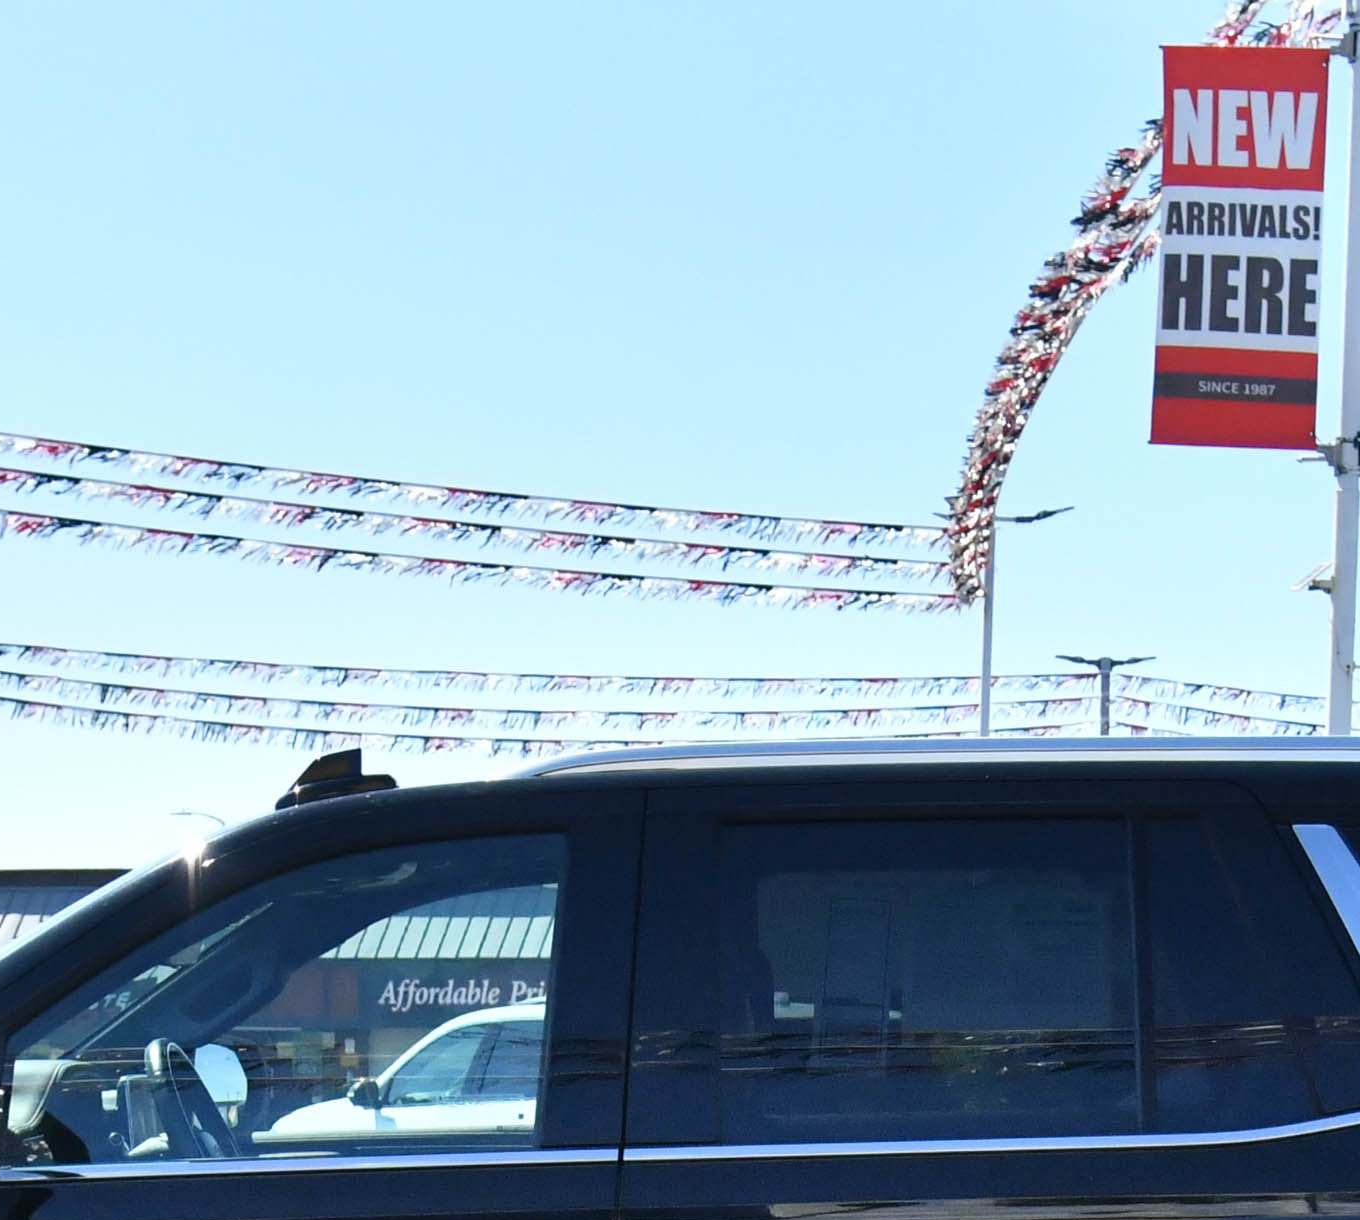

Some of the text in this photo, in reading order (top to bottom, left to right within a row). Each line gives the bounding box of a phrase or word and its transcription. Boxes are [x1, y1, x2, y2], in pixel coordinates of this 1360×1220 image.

[1172, 88, 1319, 170] NEW
[1165, 201, 1321, 240] ARRIVALS!
[1161, 253, 1318, 337] HERE
[1198, 380, 1277, 396] SINCE 1987
[378, 978, 547, 1013] Affordable Pri
